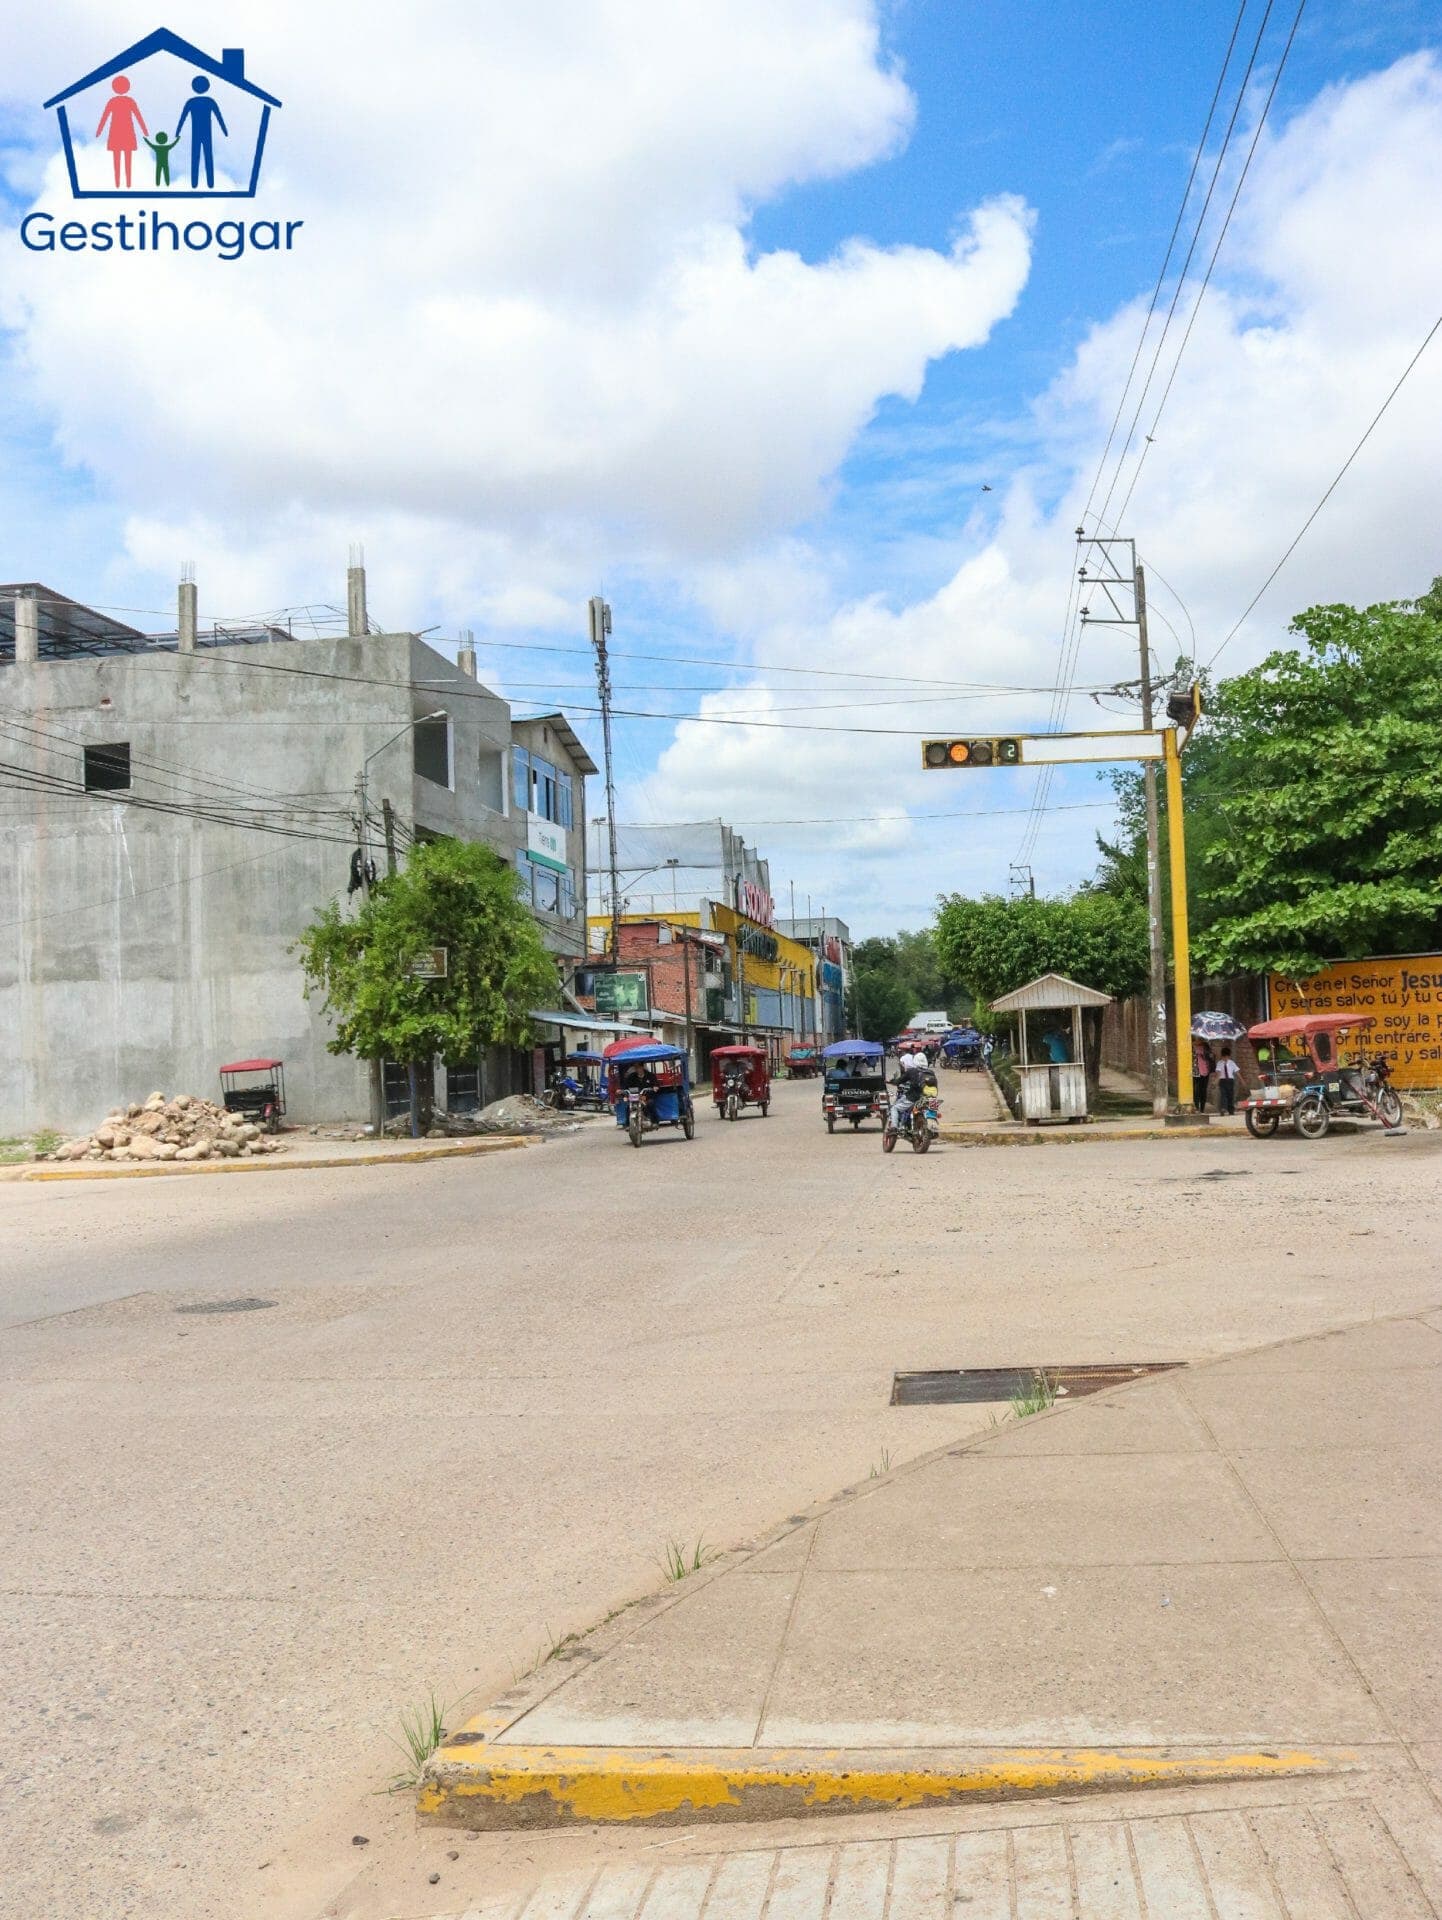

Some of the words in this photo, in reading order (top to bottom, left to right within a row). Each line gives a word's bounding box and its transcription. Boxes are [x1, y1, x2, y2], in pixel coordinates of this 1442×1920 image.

[1274, 980, 1310, 993] Cree
[1313, 981, 1332, 991] en
[1334, 977, 1347, 991] el
[1351, 974, 1394, 989] Señor
[1277, 998, 1287, 1012] y
[1336, 993, 1375, 1007] salvo
[1401, 993, 1410, 1008] y
[1414, 990, 1431, 1003] tu
[1384, 1016, 1411, 1031] soy
[1417, 1012, 1430, 1025] la
[1404, 1050, 1413, 1065] y
